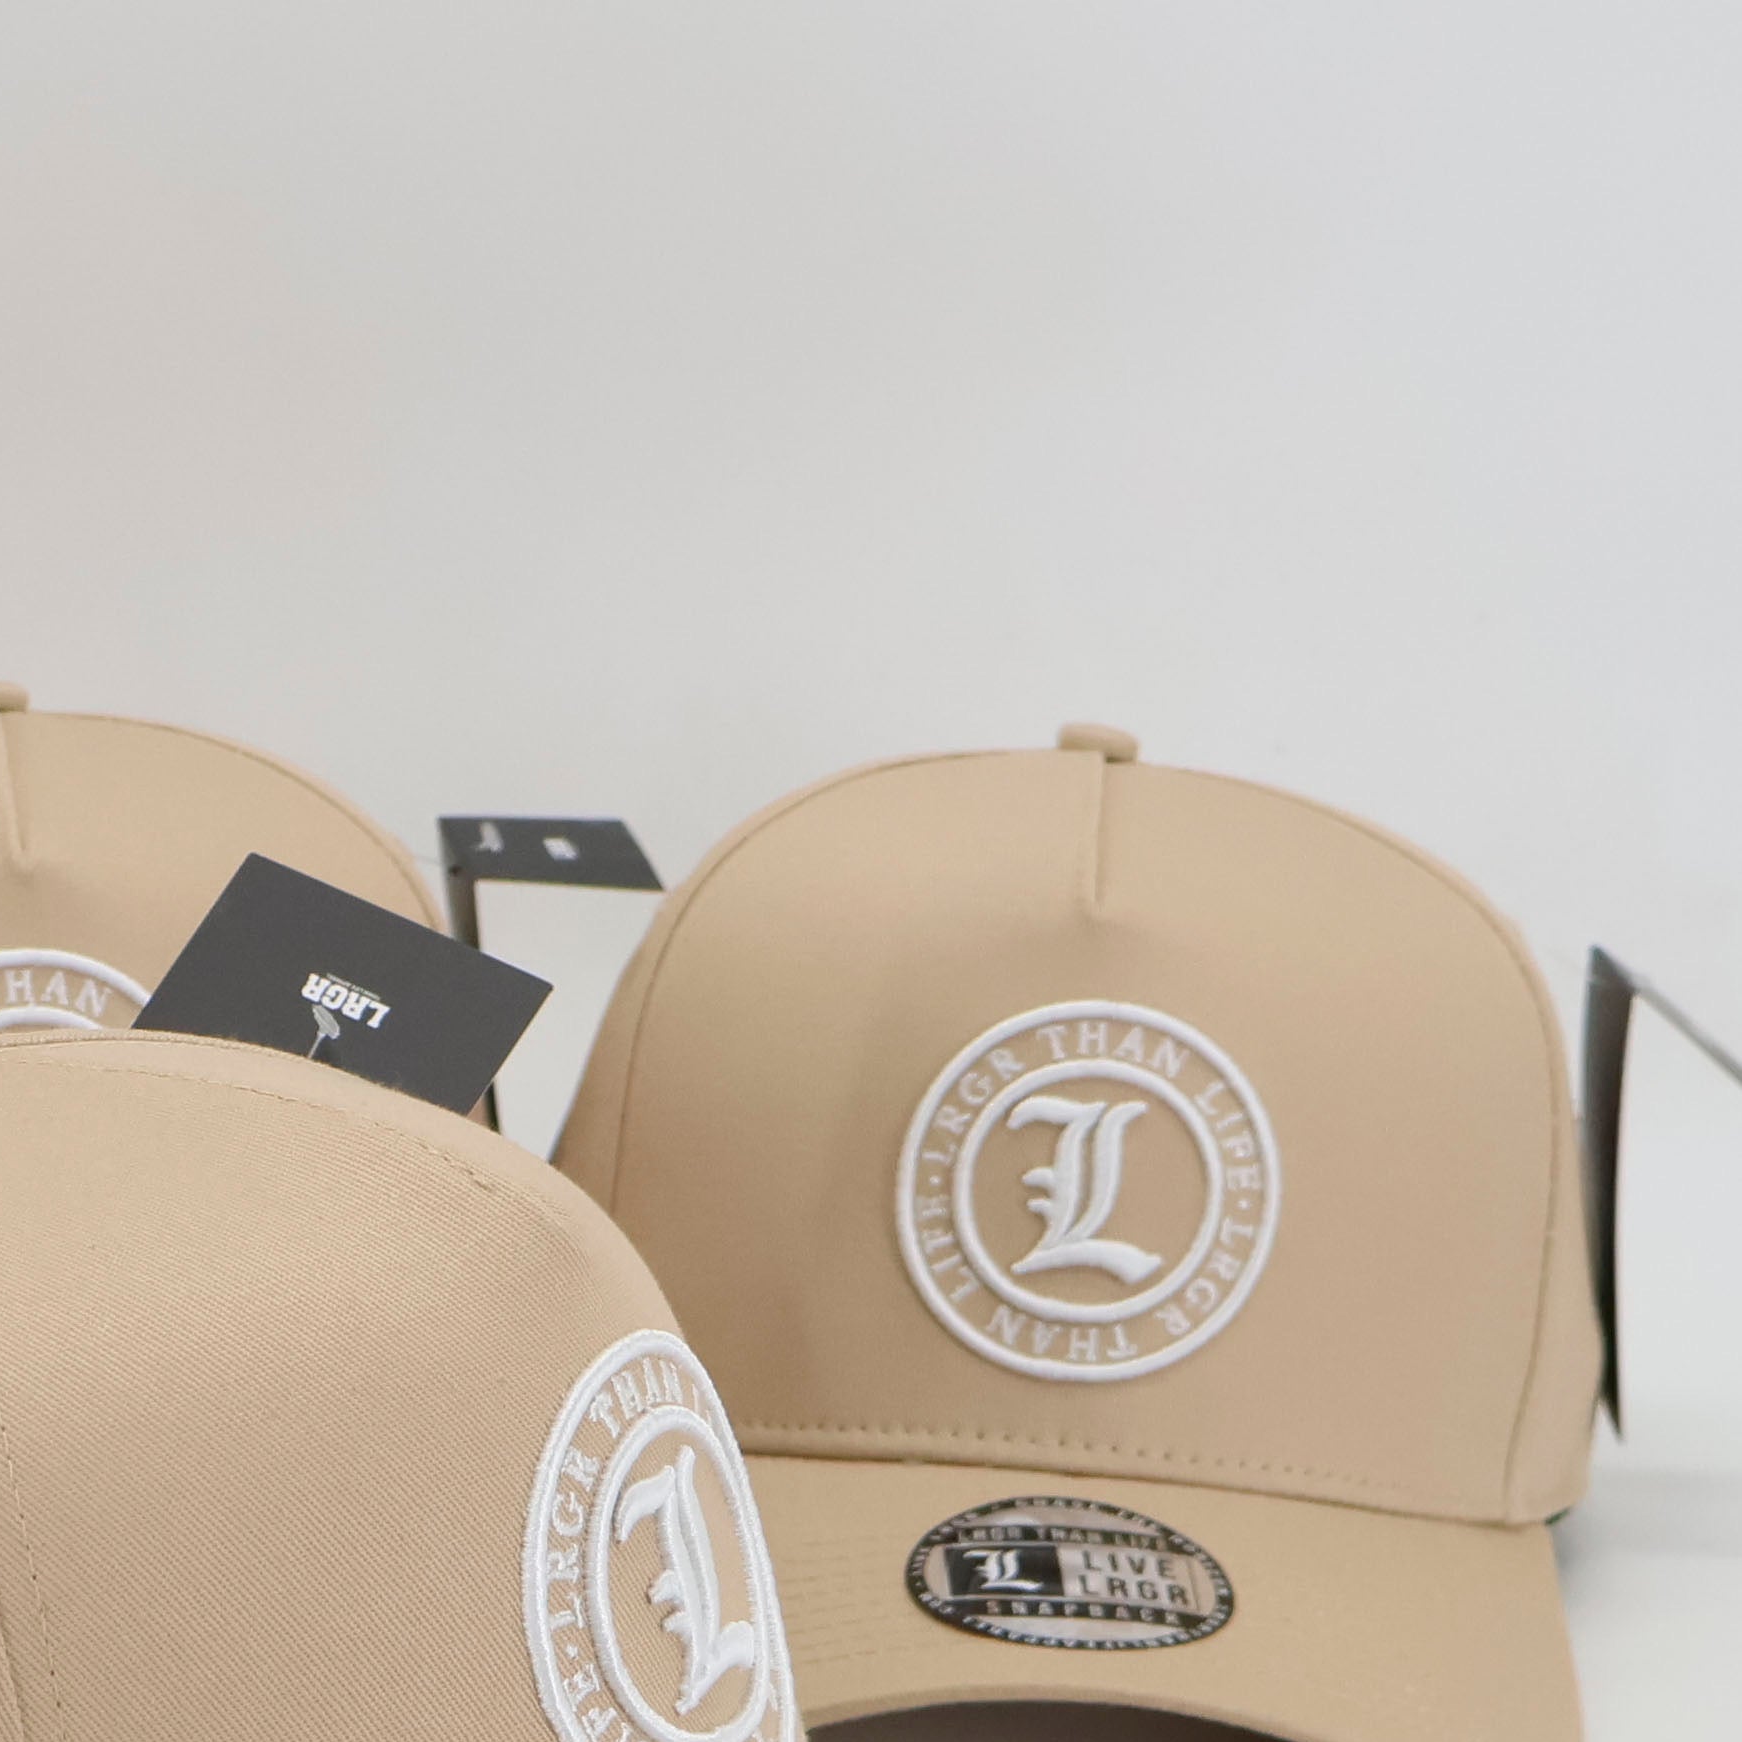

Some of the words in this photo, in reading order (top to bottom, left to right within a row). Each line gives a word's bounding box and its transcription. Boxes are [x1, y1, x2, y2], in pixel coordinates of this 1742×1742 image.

[301, 973, 390, 1028] LRGR
[922, 1048, 1025, 1165] LRGR
[1036, 1022, 1190, 1079] THAN
[1156, 1218, 1254, 1335] LRGR
[986, 1305, 1137, 1361] THAN
[590, 1356, 683, 1438] THAN
[1078, 1574, 1189, 1605] LRGR
[1082, 1550, 1176, 1580] LIVE
